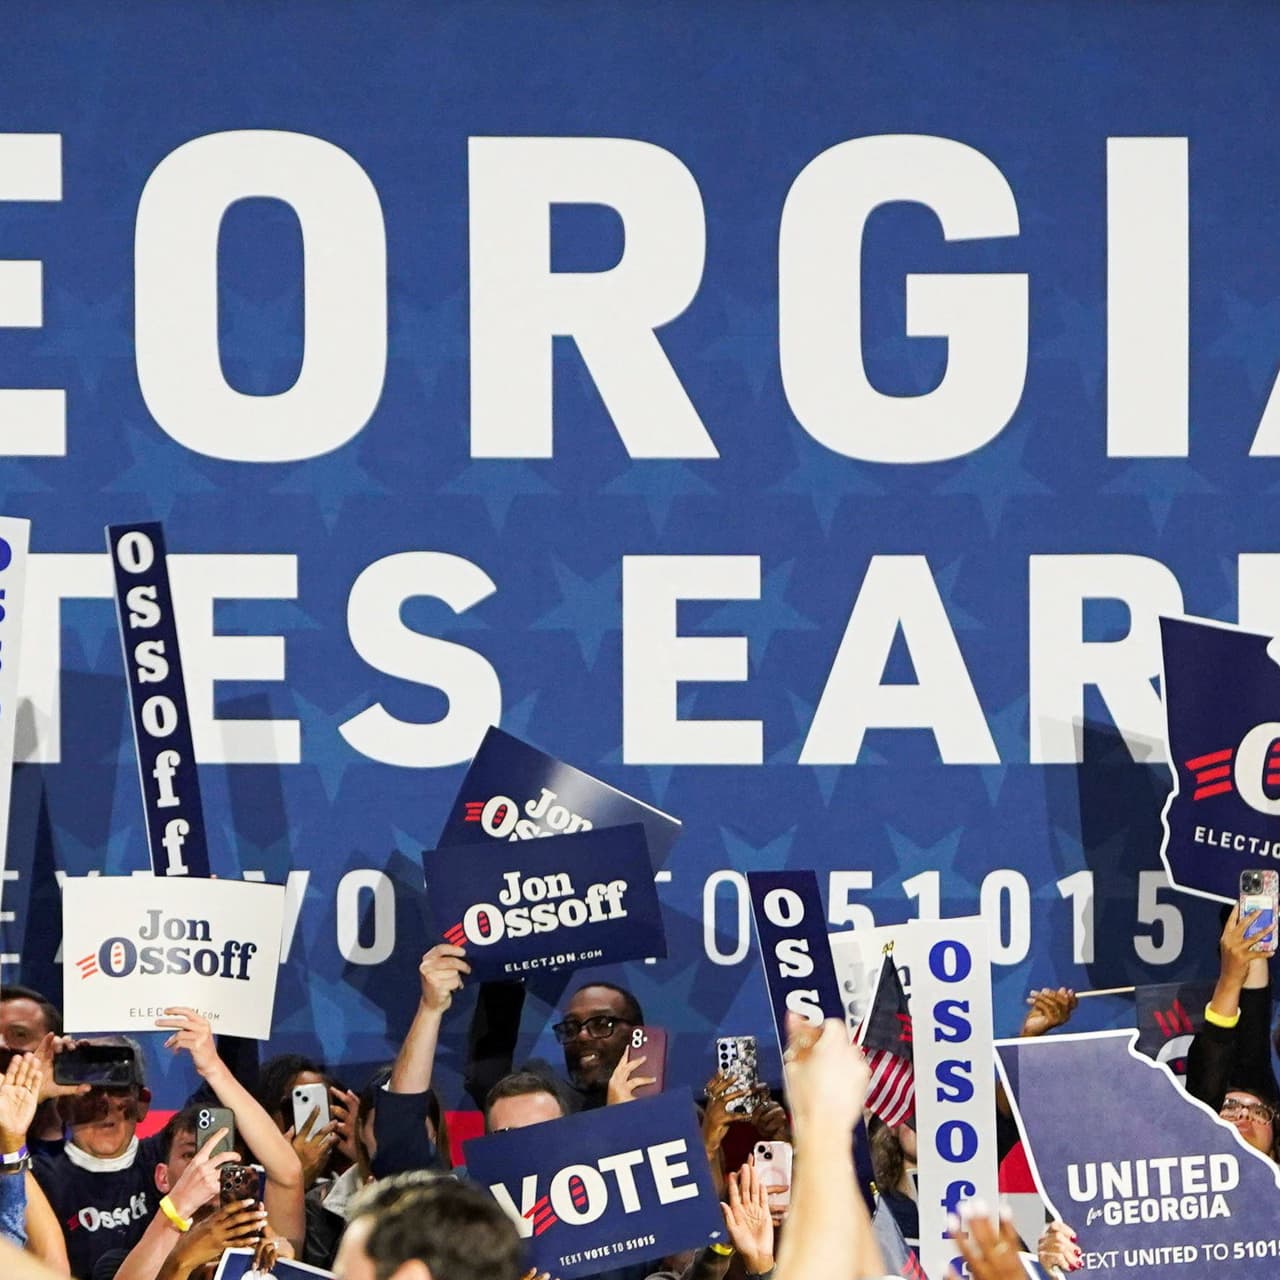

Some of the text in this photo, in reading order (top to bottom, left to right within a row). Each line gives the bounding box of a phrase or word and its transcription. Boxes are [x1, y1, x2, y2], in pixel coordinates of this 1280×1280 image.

[498, 871, 575, 906] Jon
[138, 909, 213, 942] Jon
[462, 879, 628, 946] Ossoff
[98, 936, 258, 981] Ossoff
[504, 949, 603, 973] ELECTJON.COM
[489, 1138, 700, 1240] VOTE
[1067, 1154, 1240, 1202] UNITED
[1103, 1194, 1232, 1226] GEORGIA
[559, 1255, 583, 1267] TEXT
[584, 1246, 611, 1261] VOTE
[611, 1241, 625, 1253] TO
[1124, 1246, 1198, 1267] UNITED
[1204, 1243, 1229, 1262] TO
